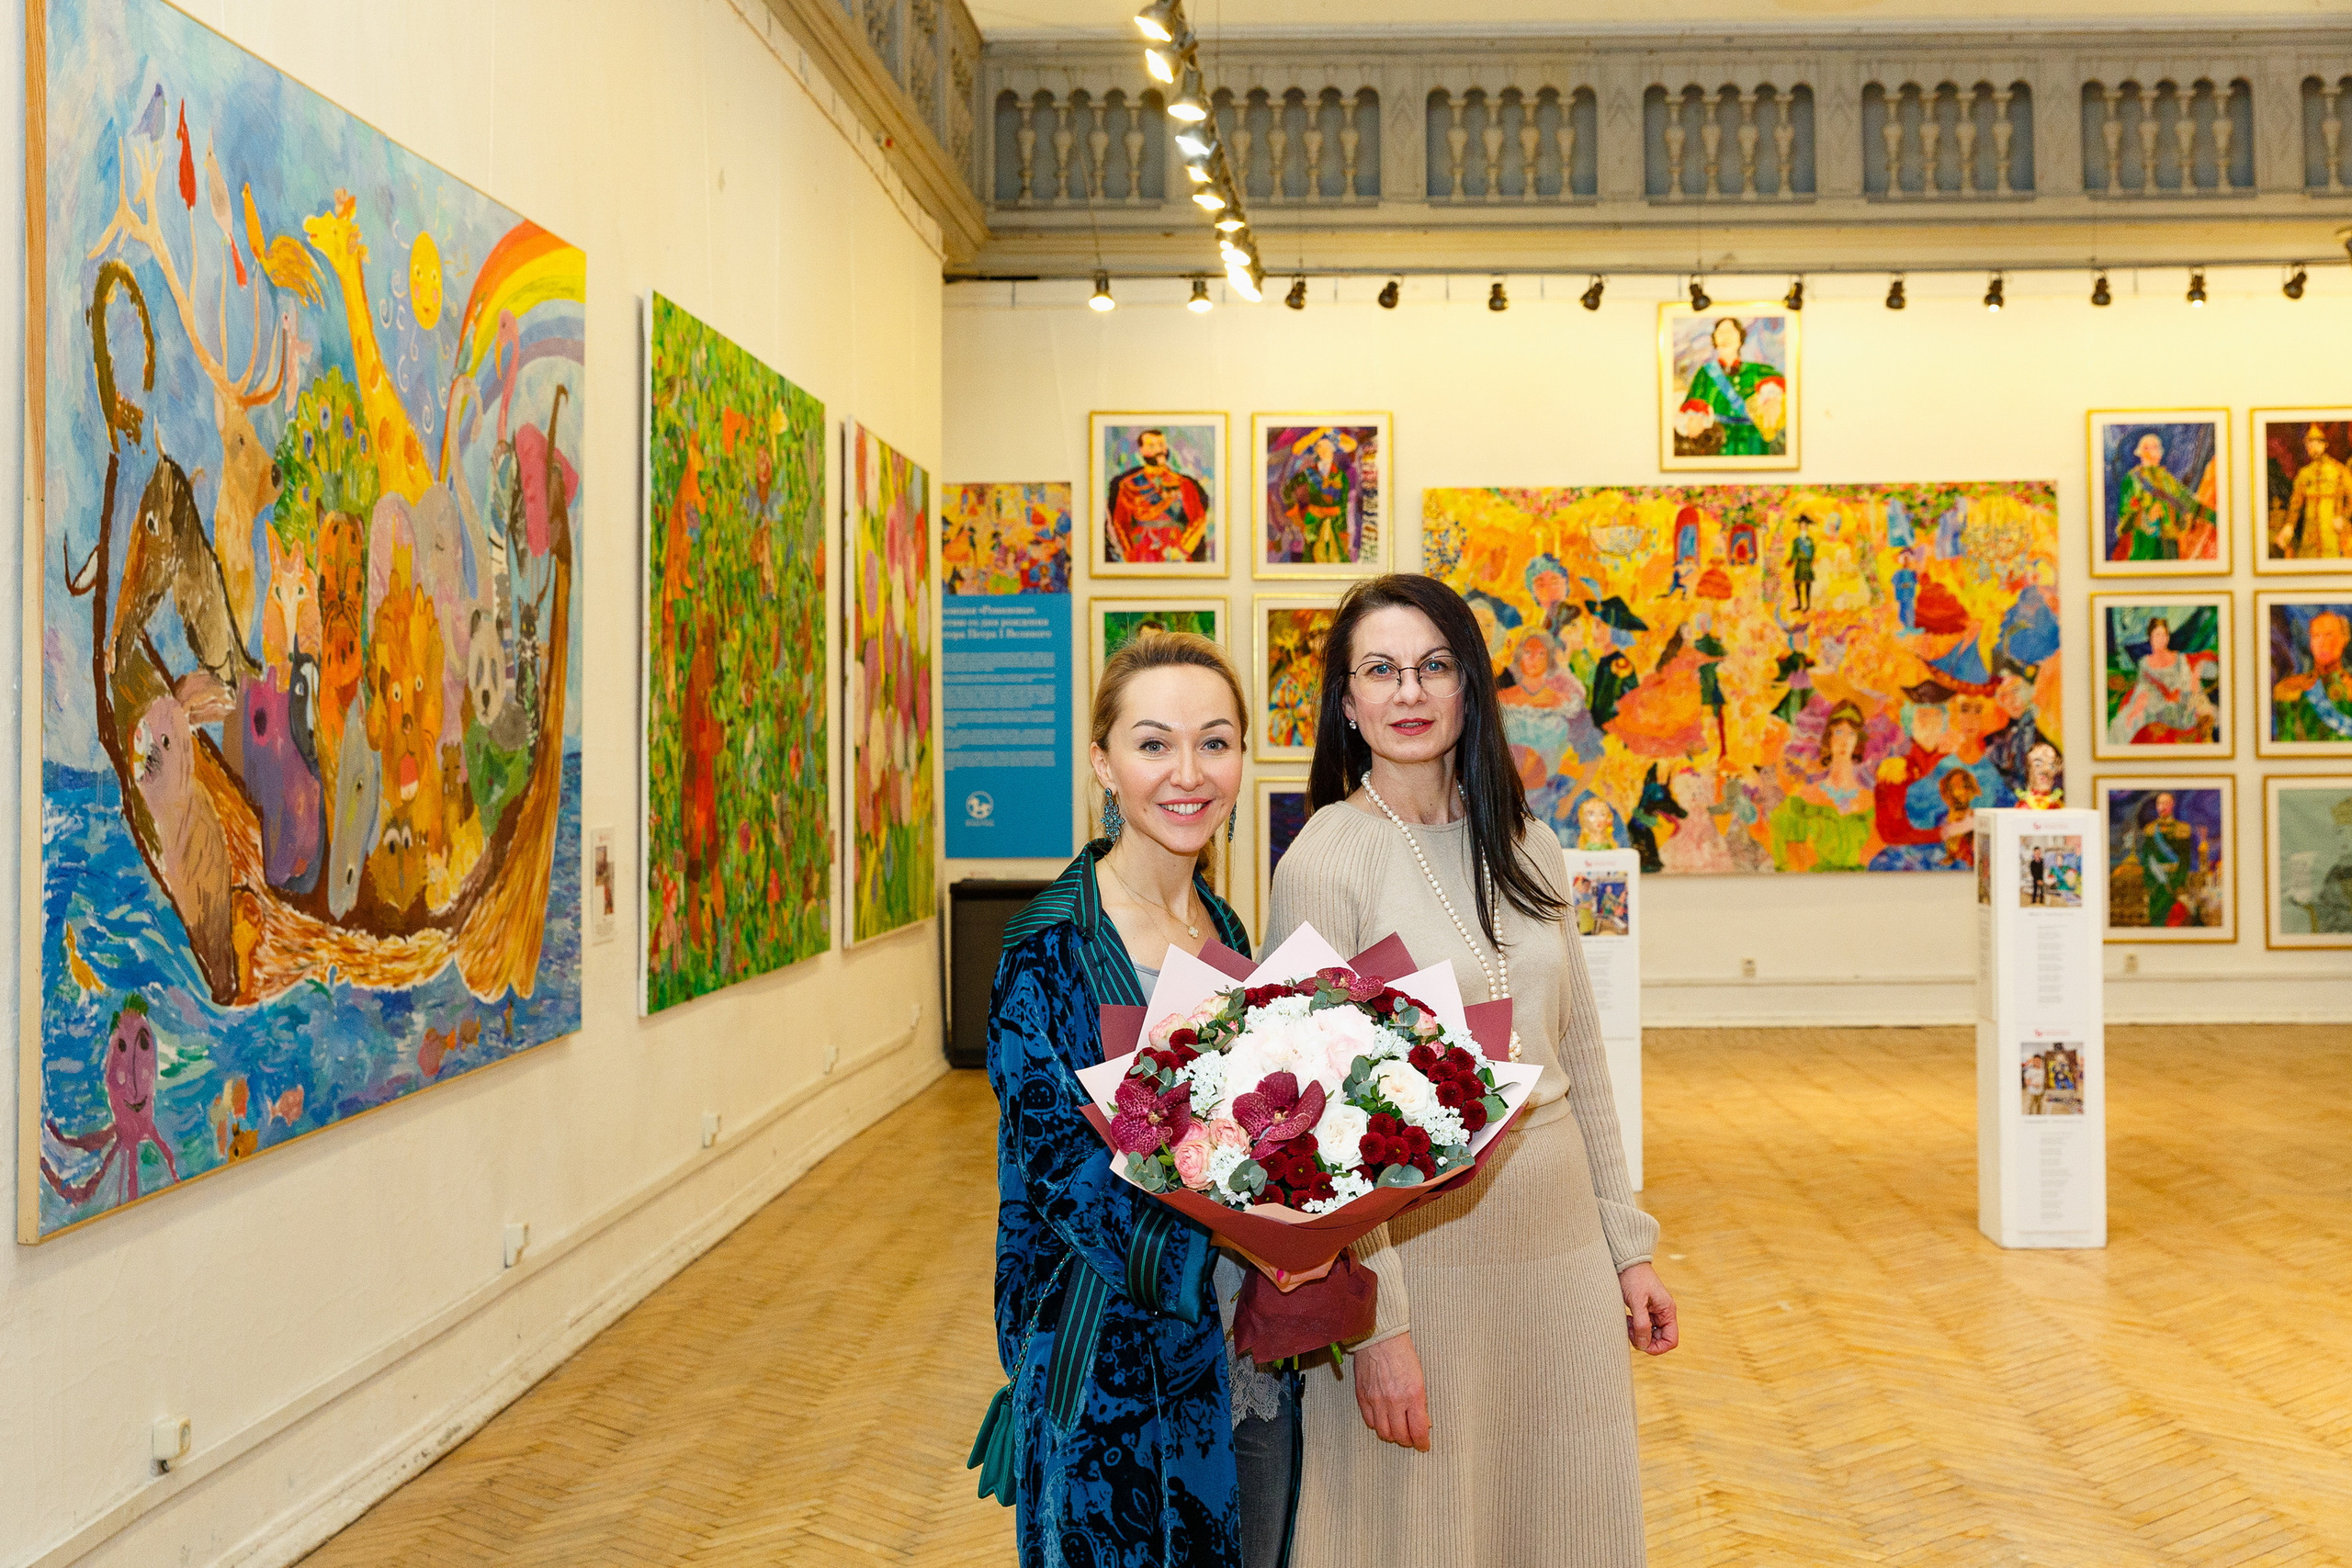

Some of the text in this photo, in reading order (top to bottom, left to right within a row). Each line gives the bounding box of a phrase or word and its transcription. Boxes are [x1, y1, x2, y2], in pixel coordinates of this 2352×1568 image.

[979, 618, 999, 627] дня
[1000, 617, 1049, 627] рождения
[967, 628, 996, 641] Петра
[998, 627, 1002, 639] I
[1004, 627, 1052, 639] Великого
